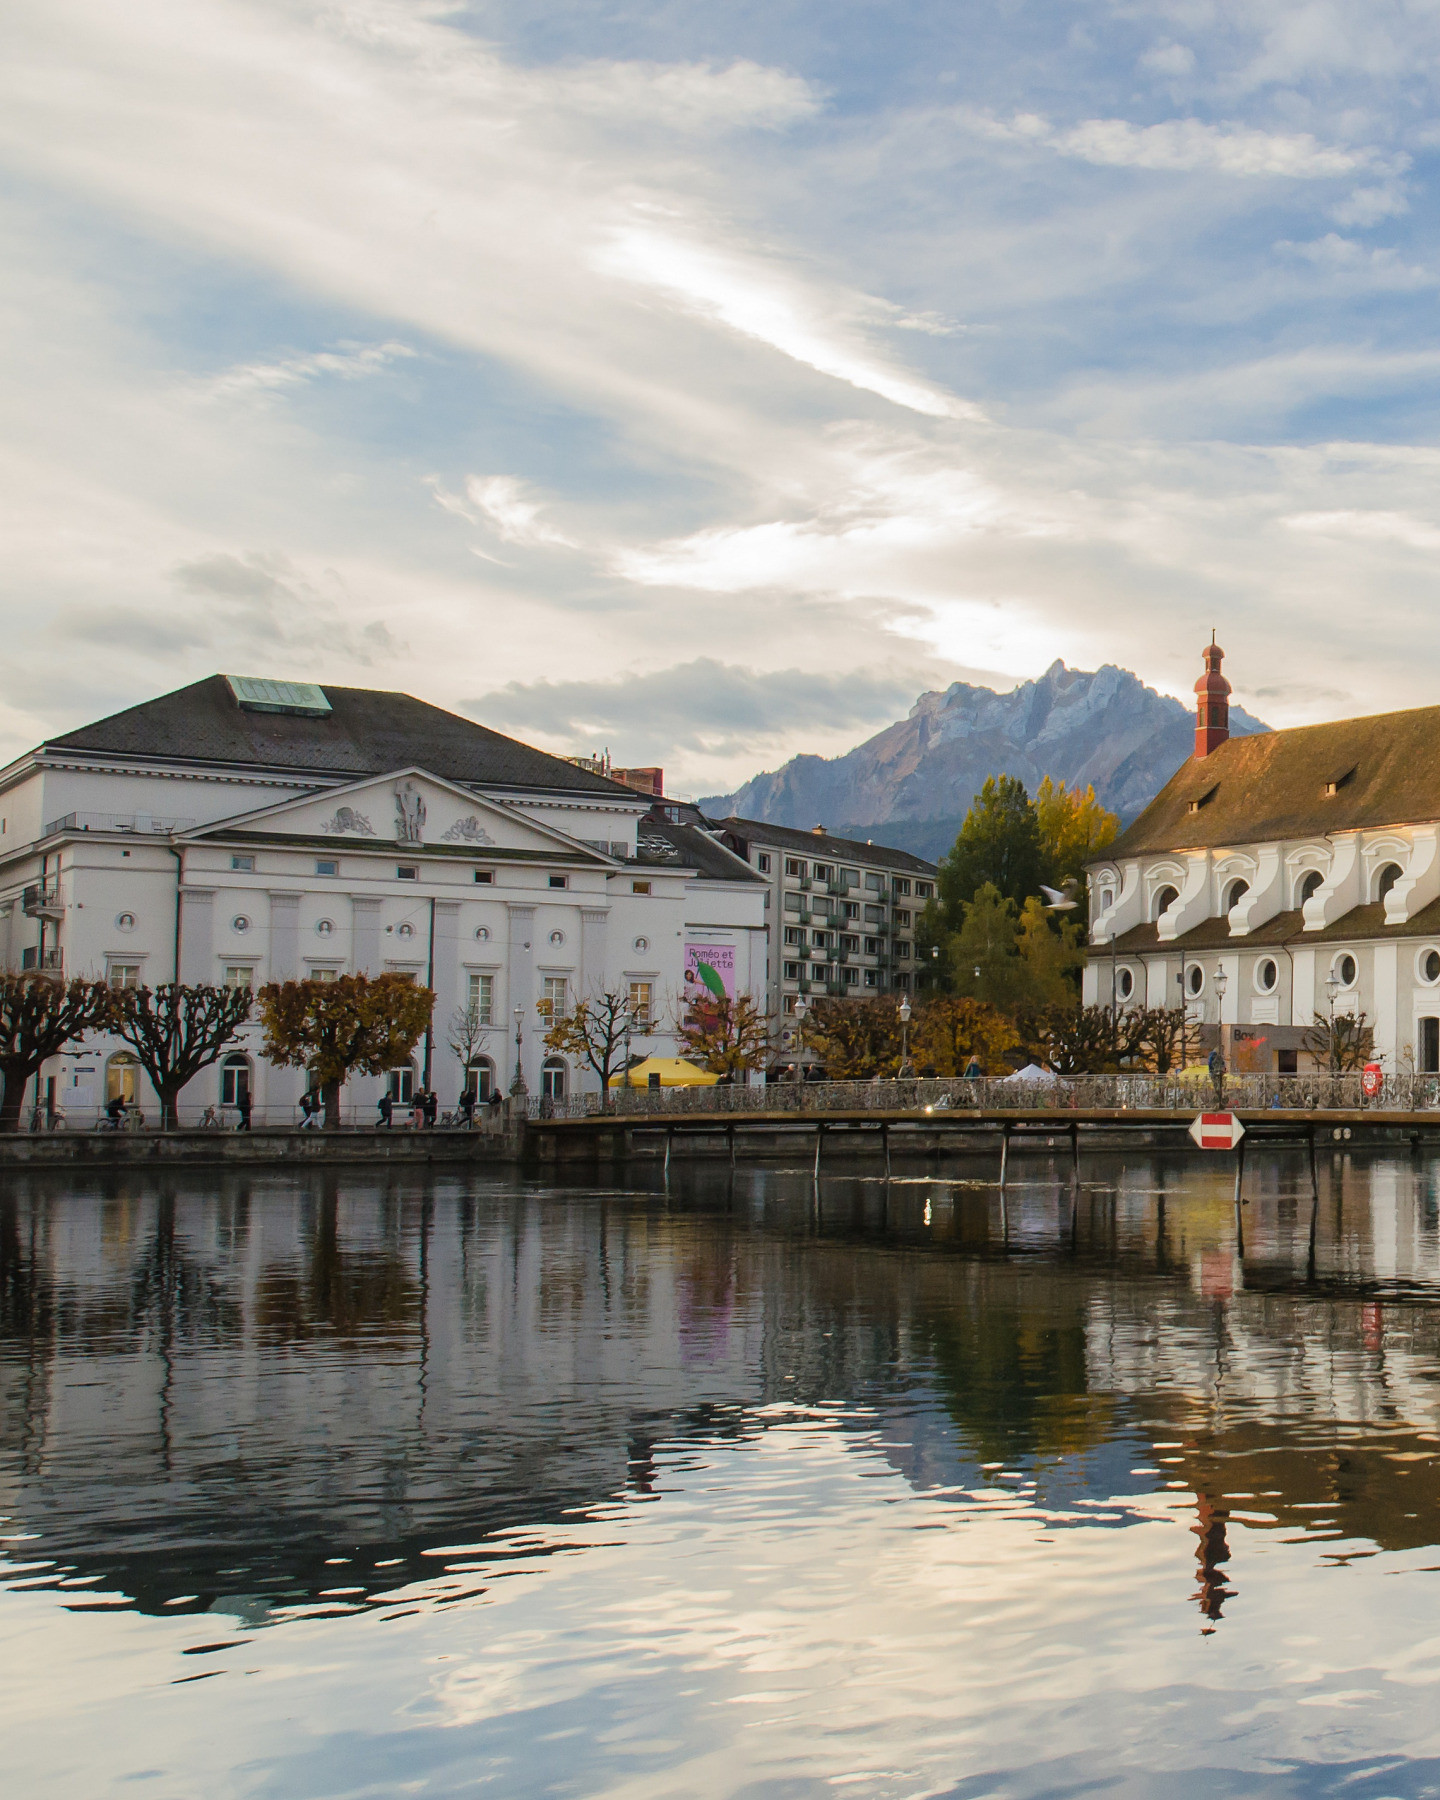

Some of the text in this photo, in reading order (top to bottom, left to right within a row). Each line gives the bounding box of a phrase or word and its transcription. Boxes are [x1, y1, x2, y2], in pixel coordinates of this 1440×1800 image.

[689, 948, 733, 959] Roméo et
[688, 958, 733, 968] Juiette
[1234, 1029, 1255, 1041] Box
